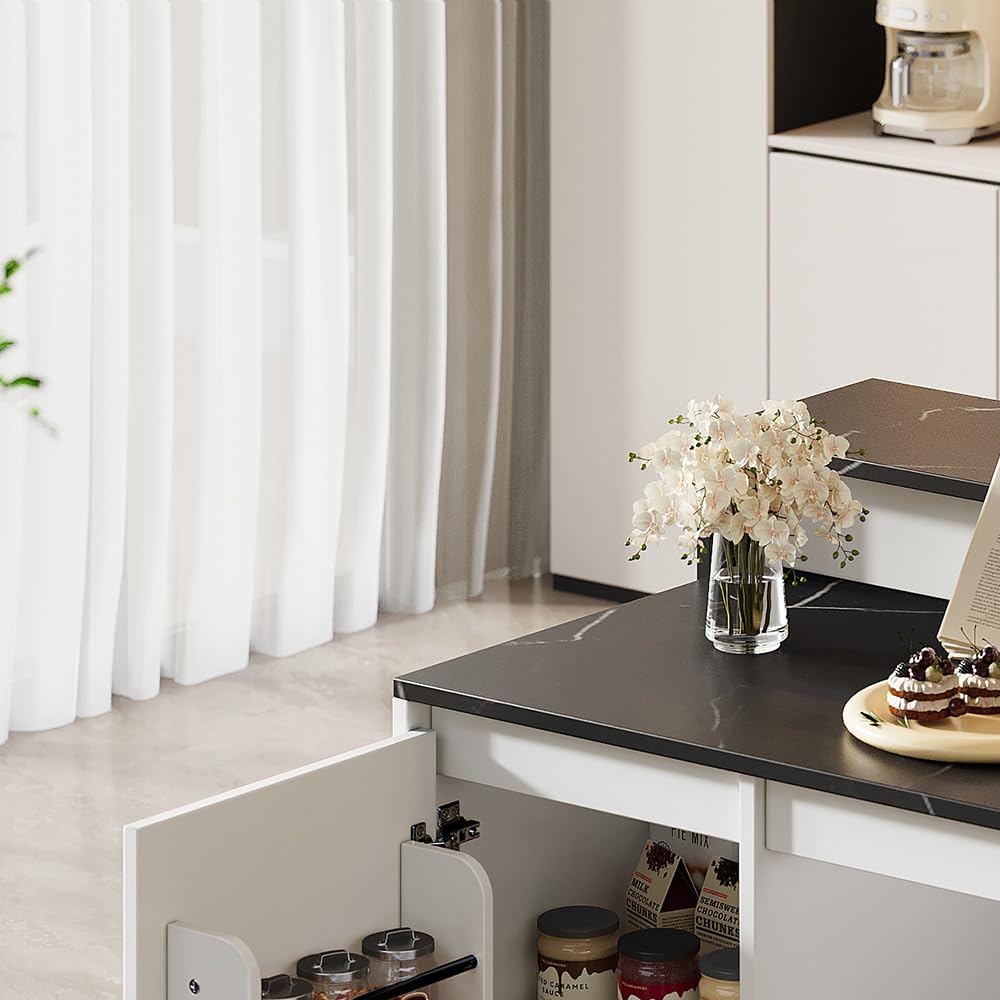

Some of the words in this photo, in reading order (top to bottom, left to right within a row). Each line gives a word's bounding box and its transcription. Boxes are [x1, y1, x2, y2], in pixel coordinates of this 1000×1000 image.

[691, 833, 710, 849] MIX
[630, 878, 650, 894] MILK
[627, 888, 661, 912] CHOCOLATE
[699, 896, 740, 915] SEMISWEE
[626, 898, 658, 923] CHUNKS
[696, 905, 740, 926] CHOCOLAT
[696, 915, 740, 937] CHUNKS
[542, 987, 564, 998] SAUCE
